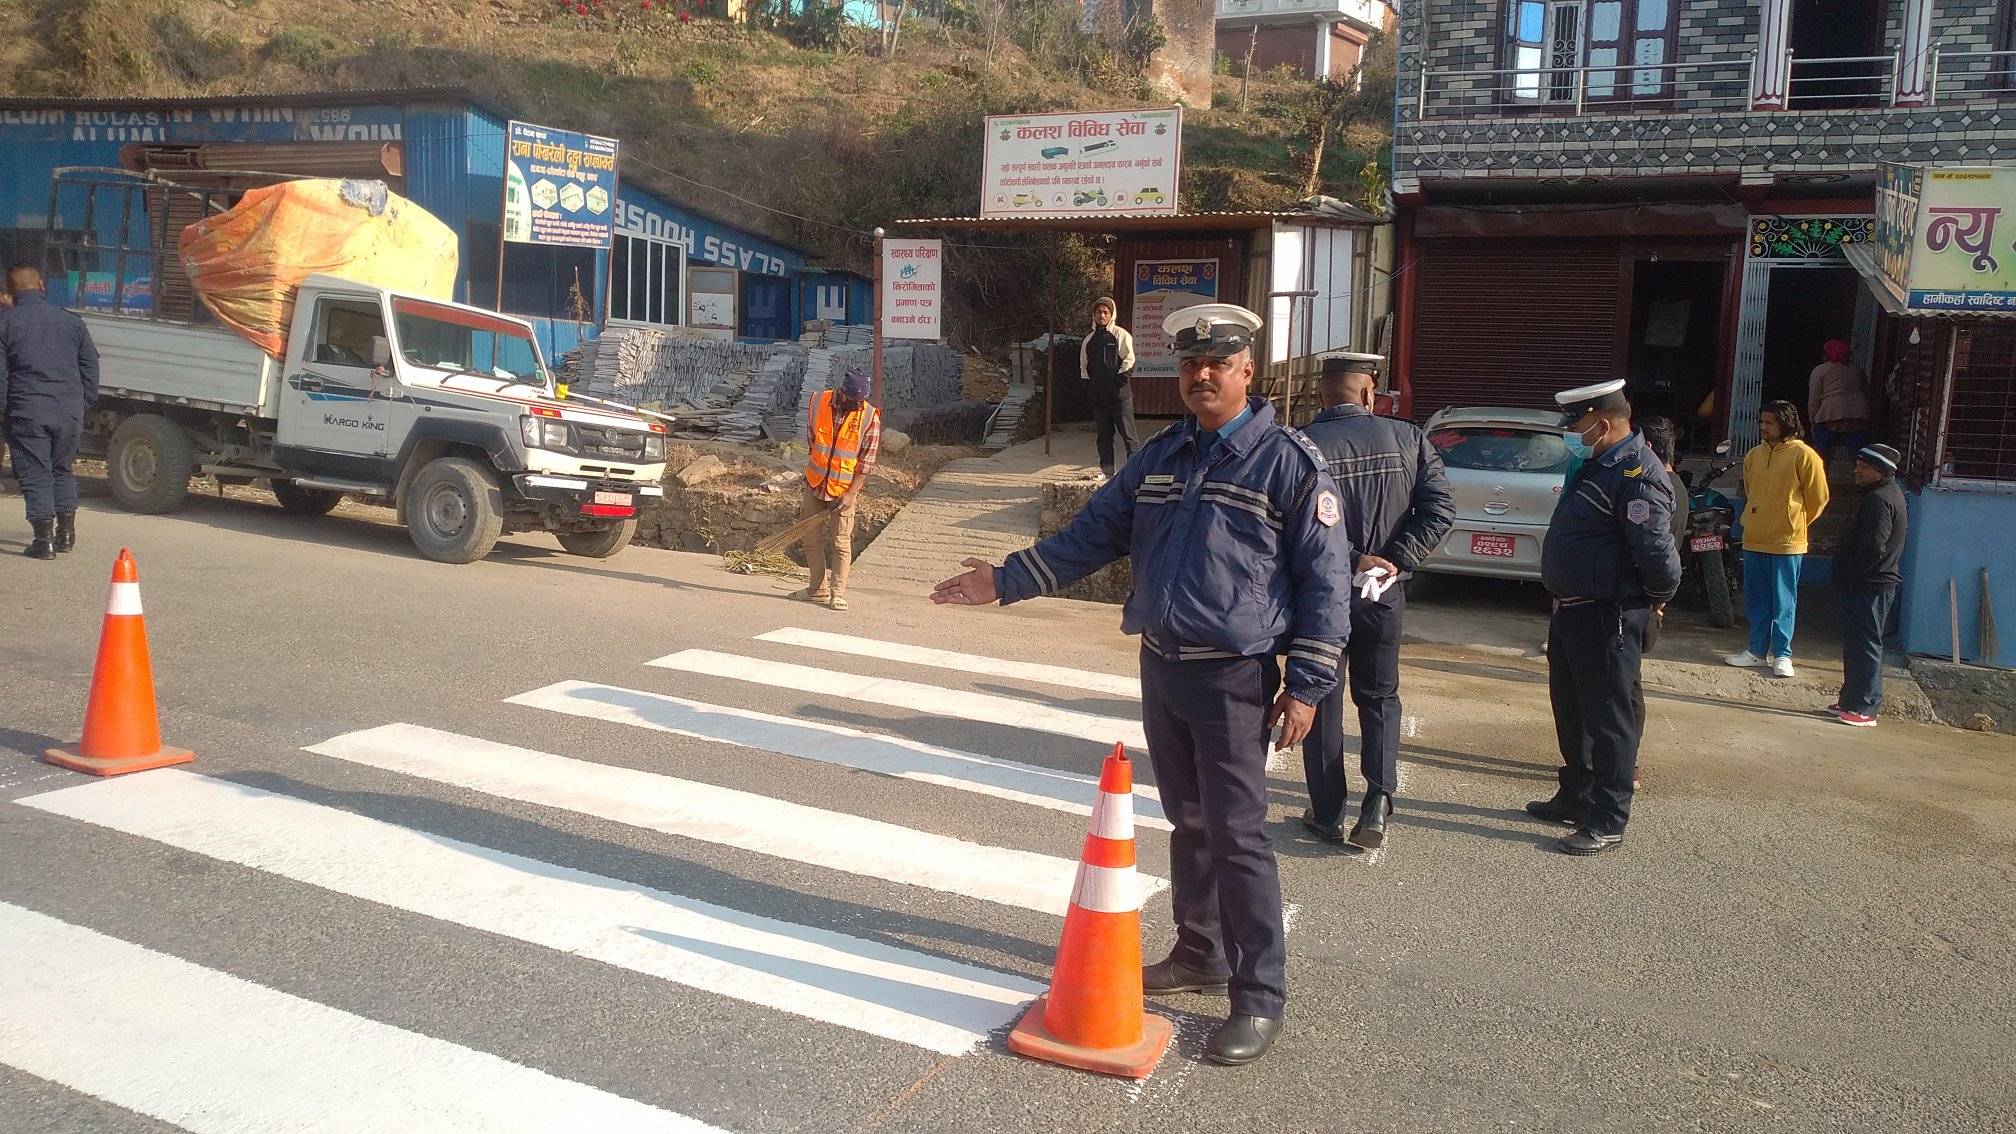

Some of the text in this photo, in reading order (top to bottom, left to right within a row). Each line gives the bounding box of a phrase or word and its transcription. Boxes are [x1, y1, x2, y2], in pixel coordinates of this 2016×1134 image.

[1016, 118, 1148, 140] कलश विविध सेवा
[512, 140, 532, 157] राना
[615, 198, 785, 277] GLASS HOUSE
[1925, 207, 2002, 273] न्यू
[1157, 265, 1193, 274] कलश
[1179, 275, 1197, 285] सेवा
[895, 299, 933, 308] प्रमाण पत्र
[1967, 292, 2005, 306] स्वादिष्ट
[890, 315, 916, 324] बनाउने
[323, 413, 385, 431] KARGO KING
